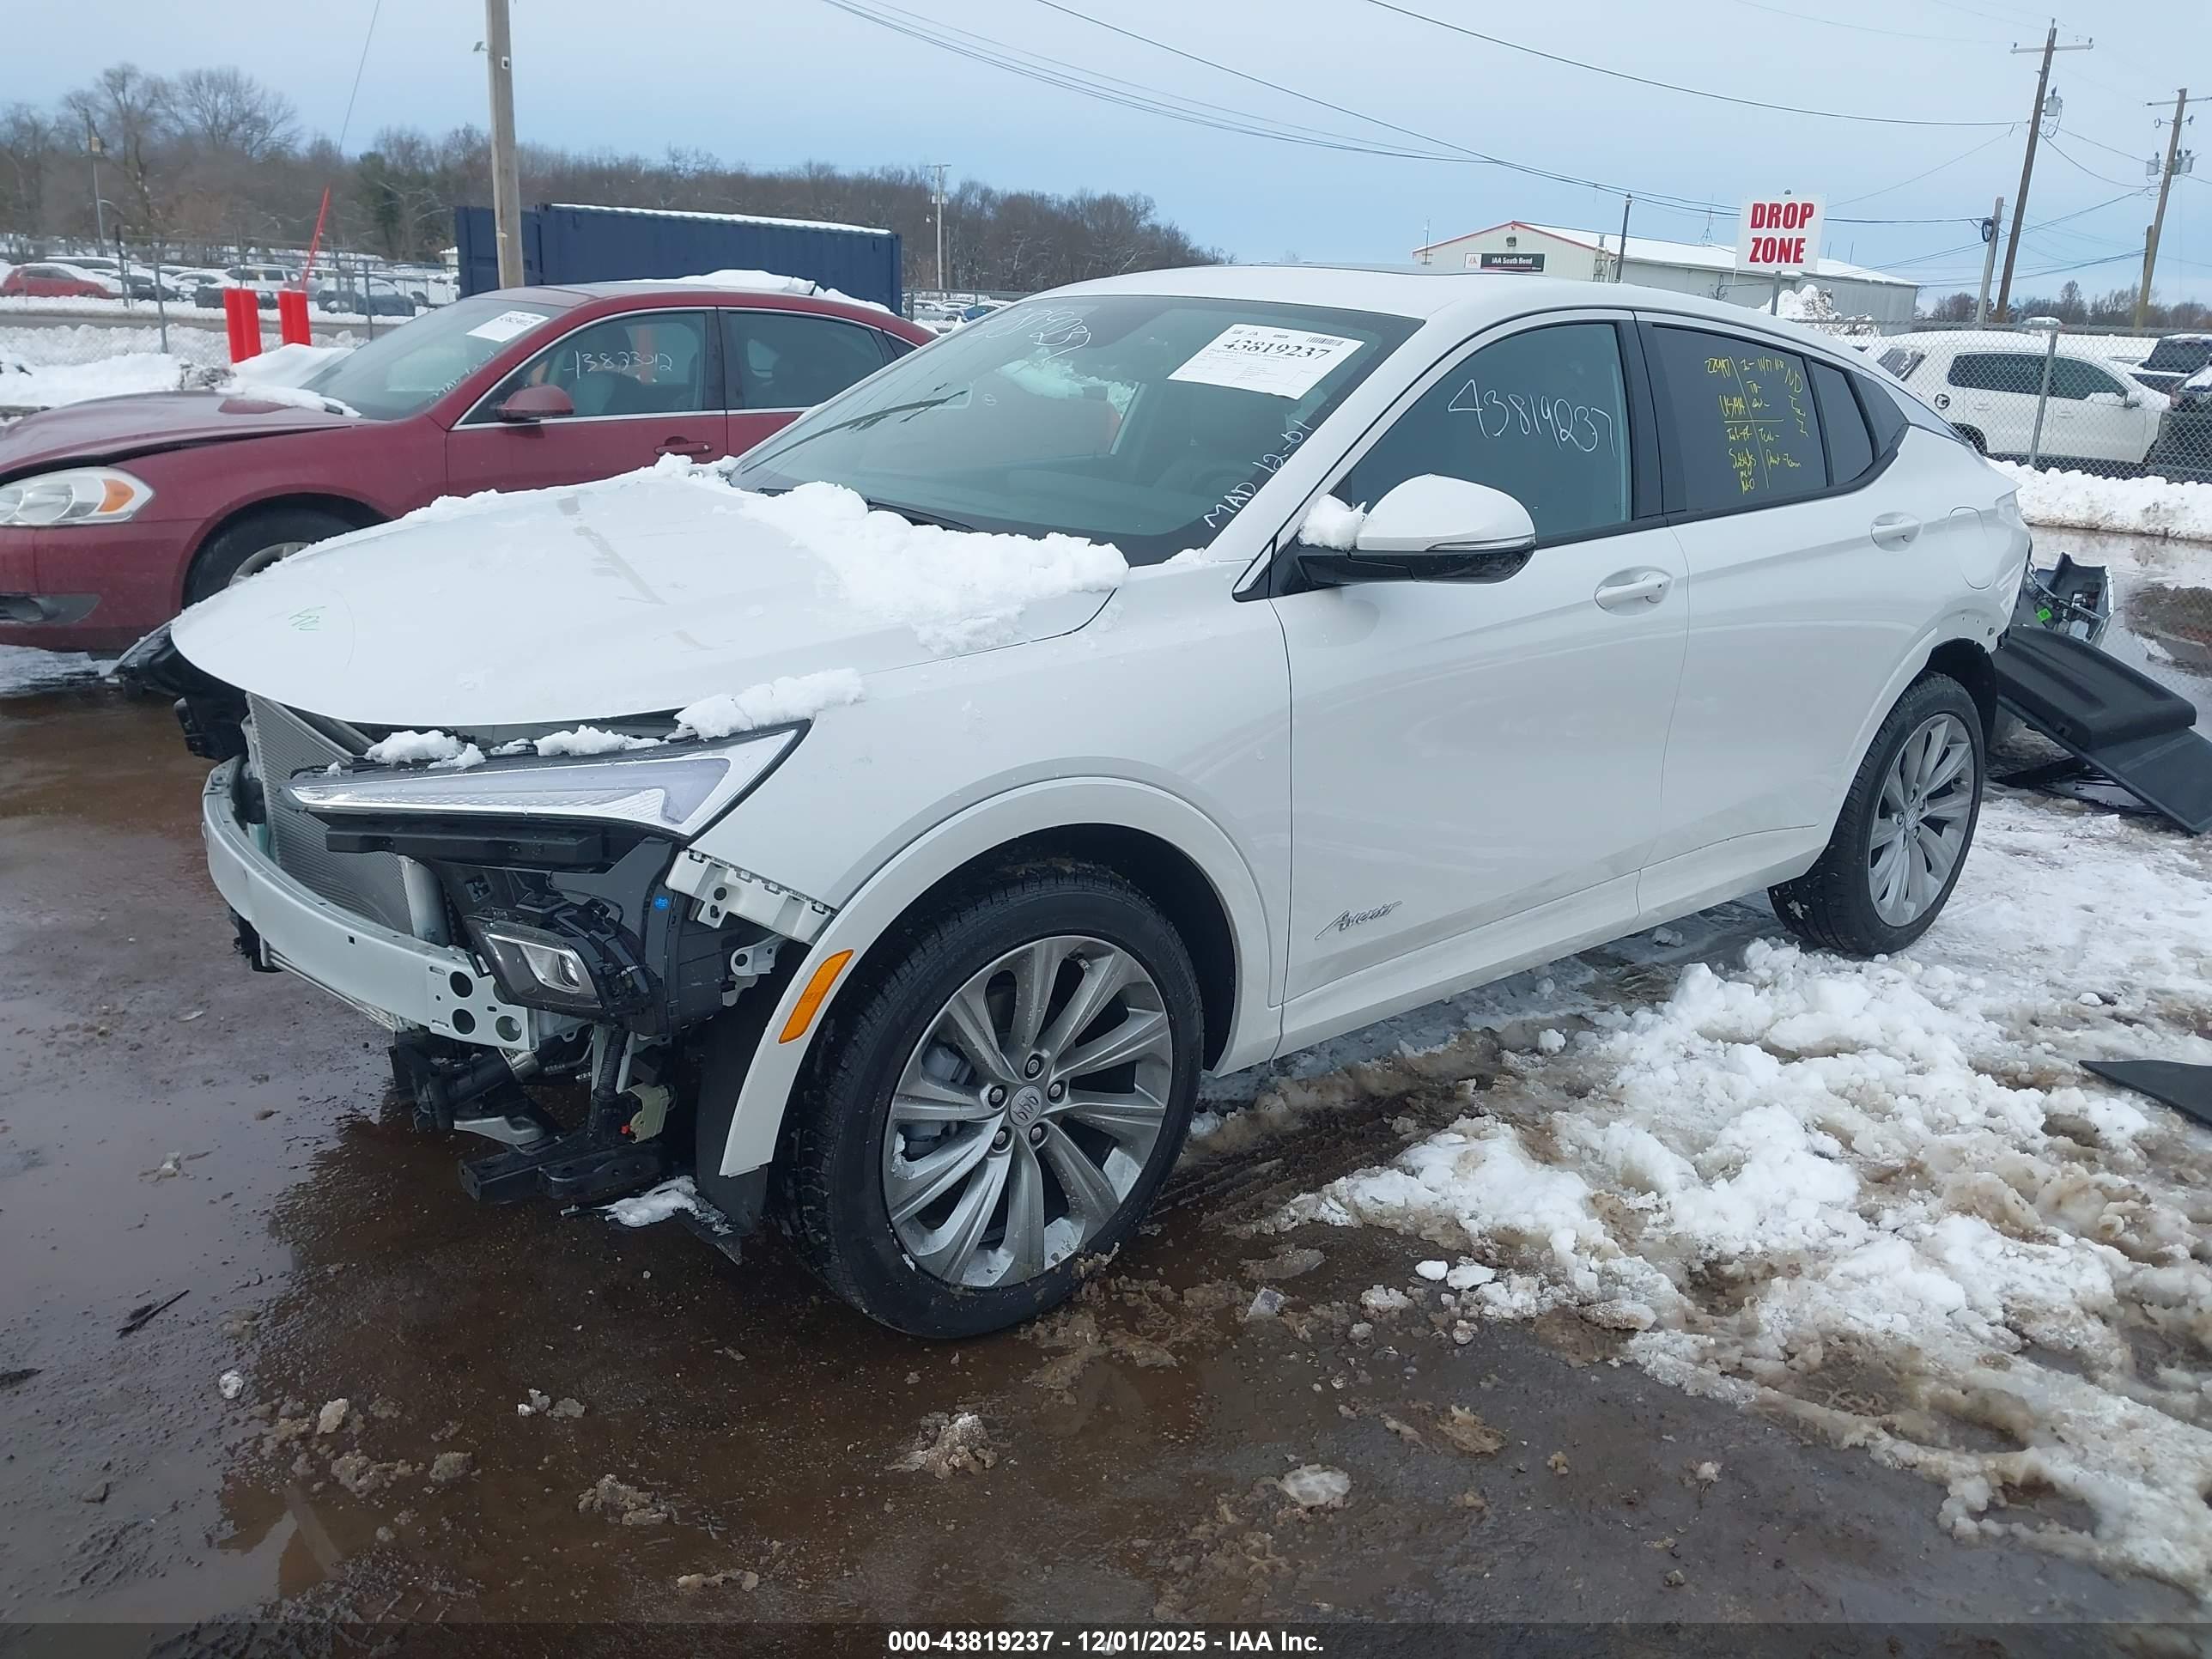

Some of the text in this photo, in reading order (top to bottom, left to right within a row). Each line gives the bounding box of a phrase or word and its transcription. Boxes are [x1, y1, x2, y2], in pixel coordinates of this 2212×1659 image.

[1750, 202, 1814, 228] DROP
[1749, 237, 1806, 263] ZONE
[1223, 338, 1332, 360] 43819237
[1447, 378, 1616, 458] 43819237
[1203, 482, 1256, 528] MAD
